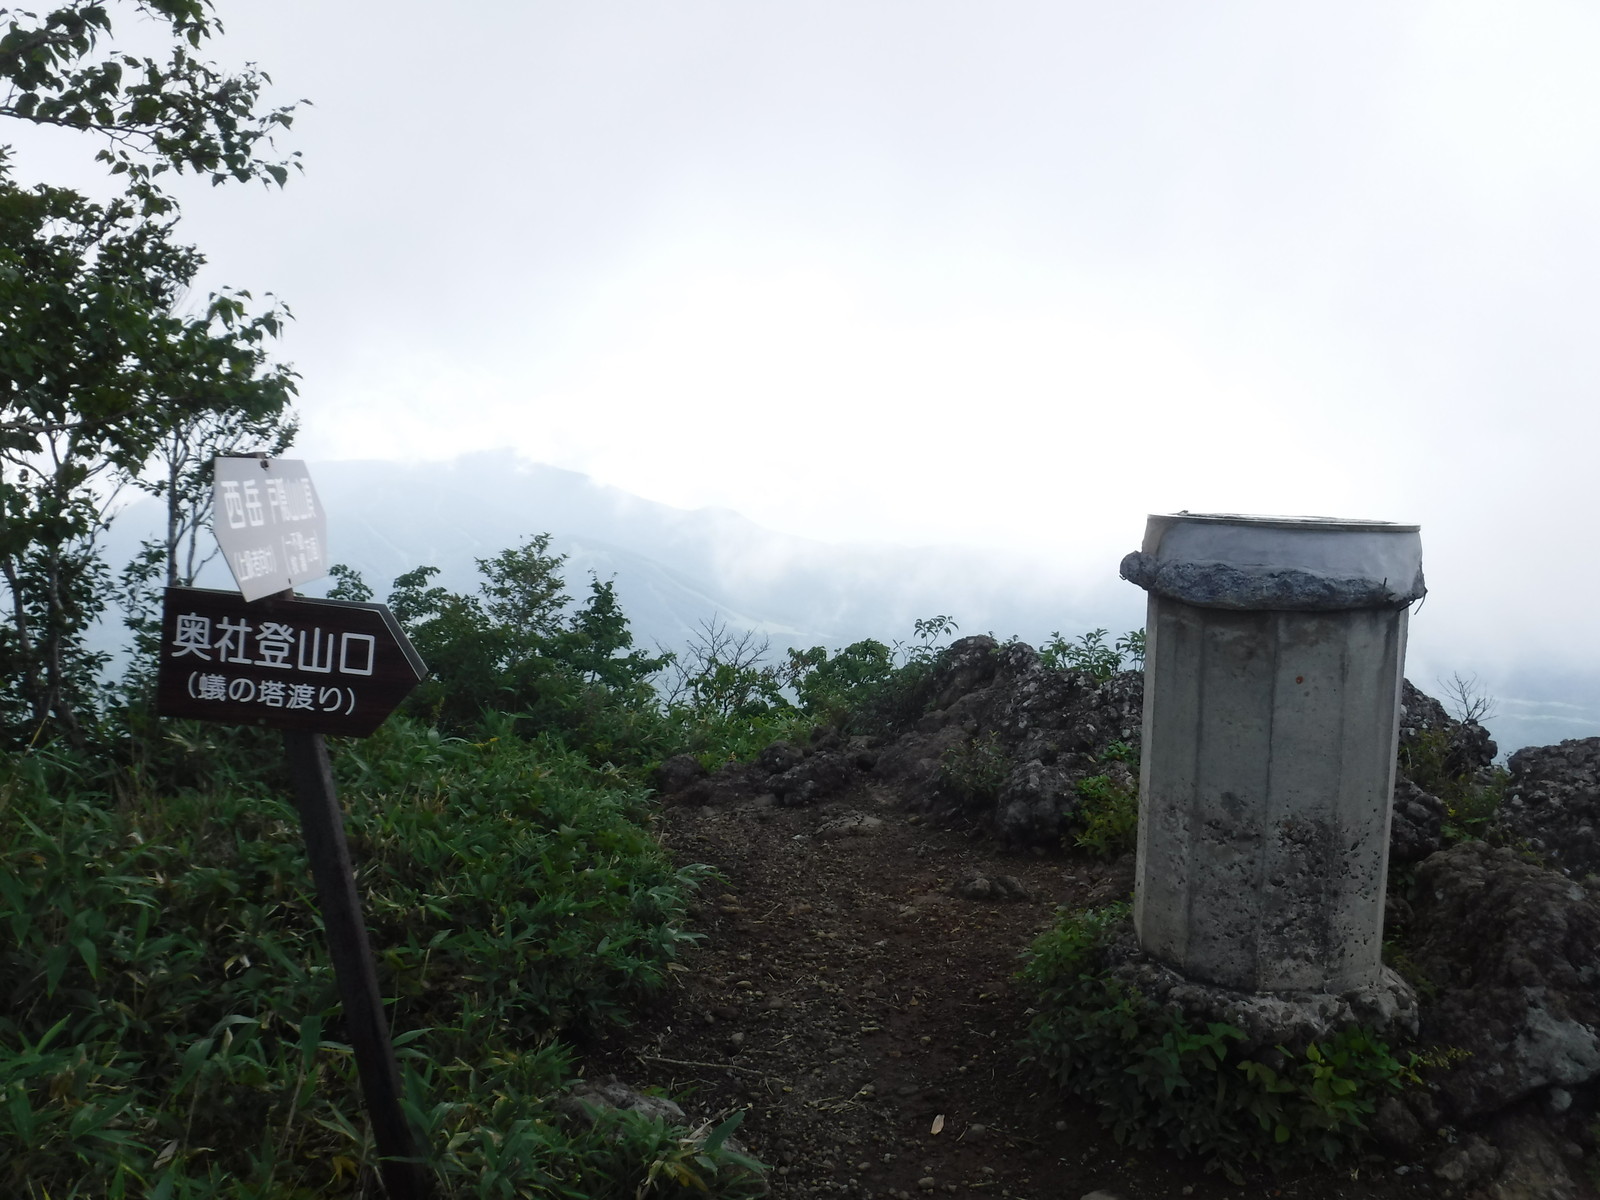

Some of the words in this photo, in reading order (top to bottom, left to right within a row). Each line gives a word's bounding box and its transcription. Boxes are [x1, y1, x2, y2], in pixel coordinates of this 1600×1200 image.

[171, 612, 375, 676] 奥社登山口
[187, 671, 356, 715] (蟻の塔渡り)
